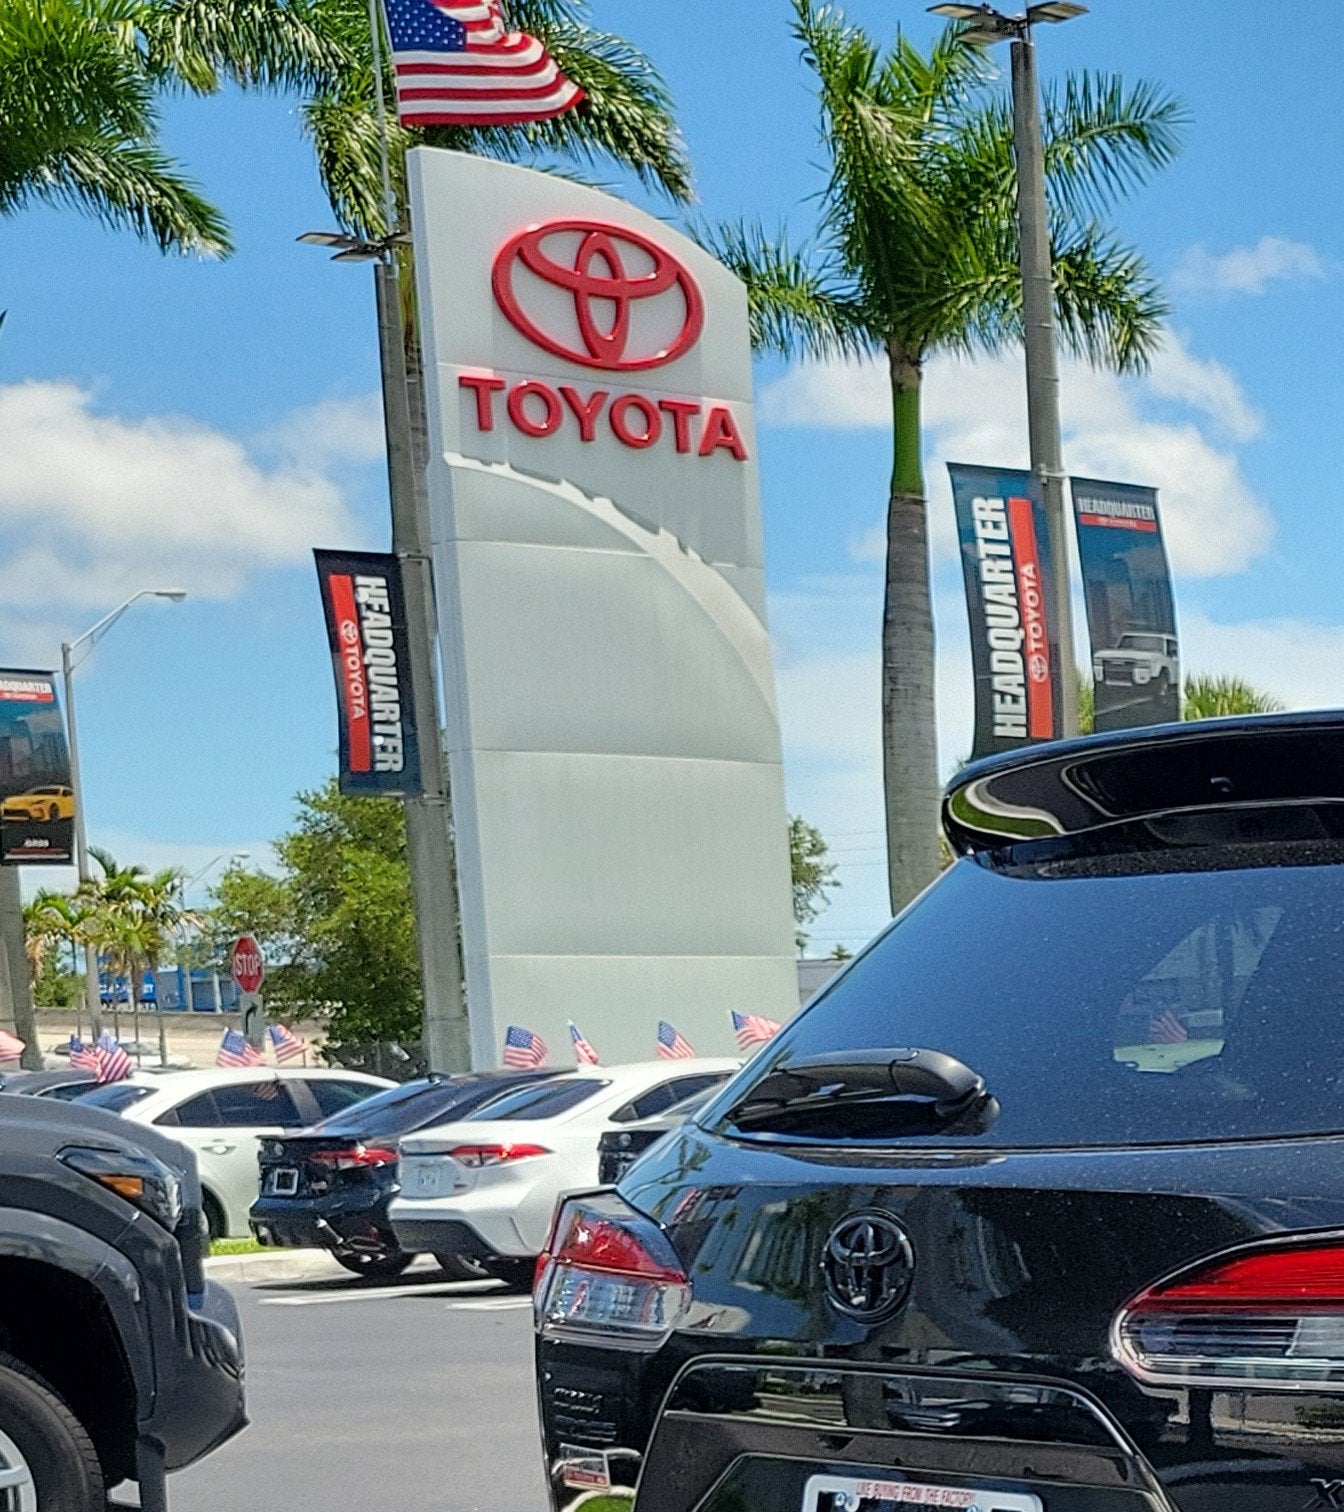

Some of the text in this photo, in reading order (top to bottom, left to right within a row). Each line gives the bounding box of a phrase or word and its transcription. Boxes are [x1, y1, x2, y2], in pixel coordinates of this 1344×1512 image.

[458, 375, 748, 461] TOYOTA
[971, 496, 1028, 737] HEADQUARTER
[1019, 562, 1044, 650] TOYOTA
[343, 648, 367, 720] TOYOTA
[355, 575, 404, 772] HEADQUARTER
[235, 953, 261, 976] STOP
